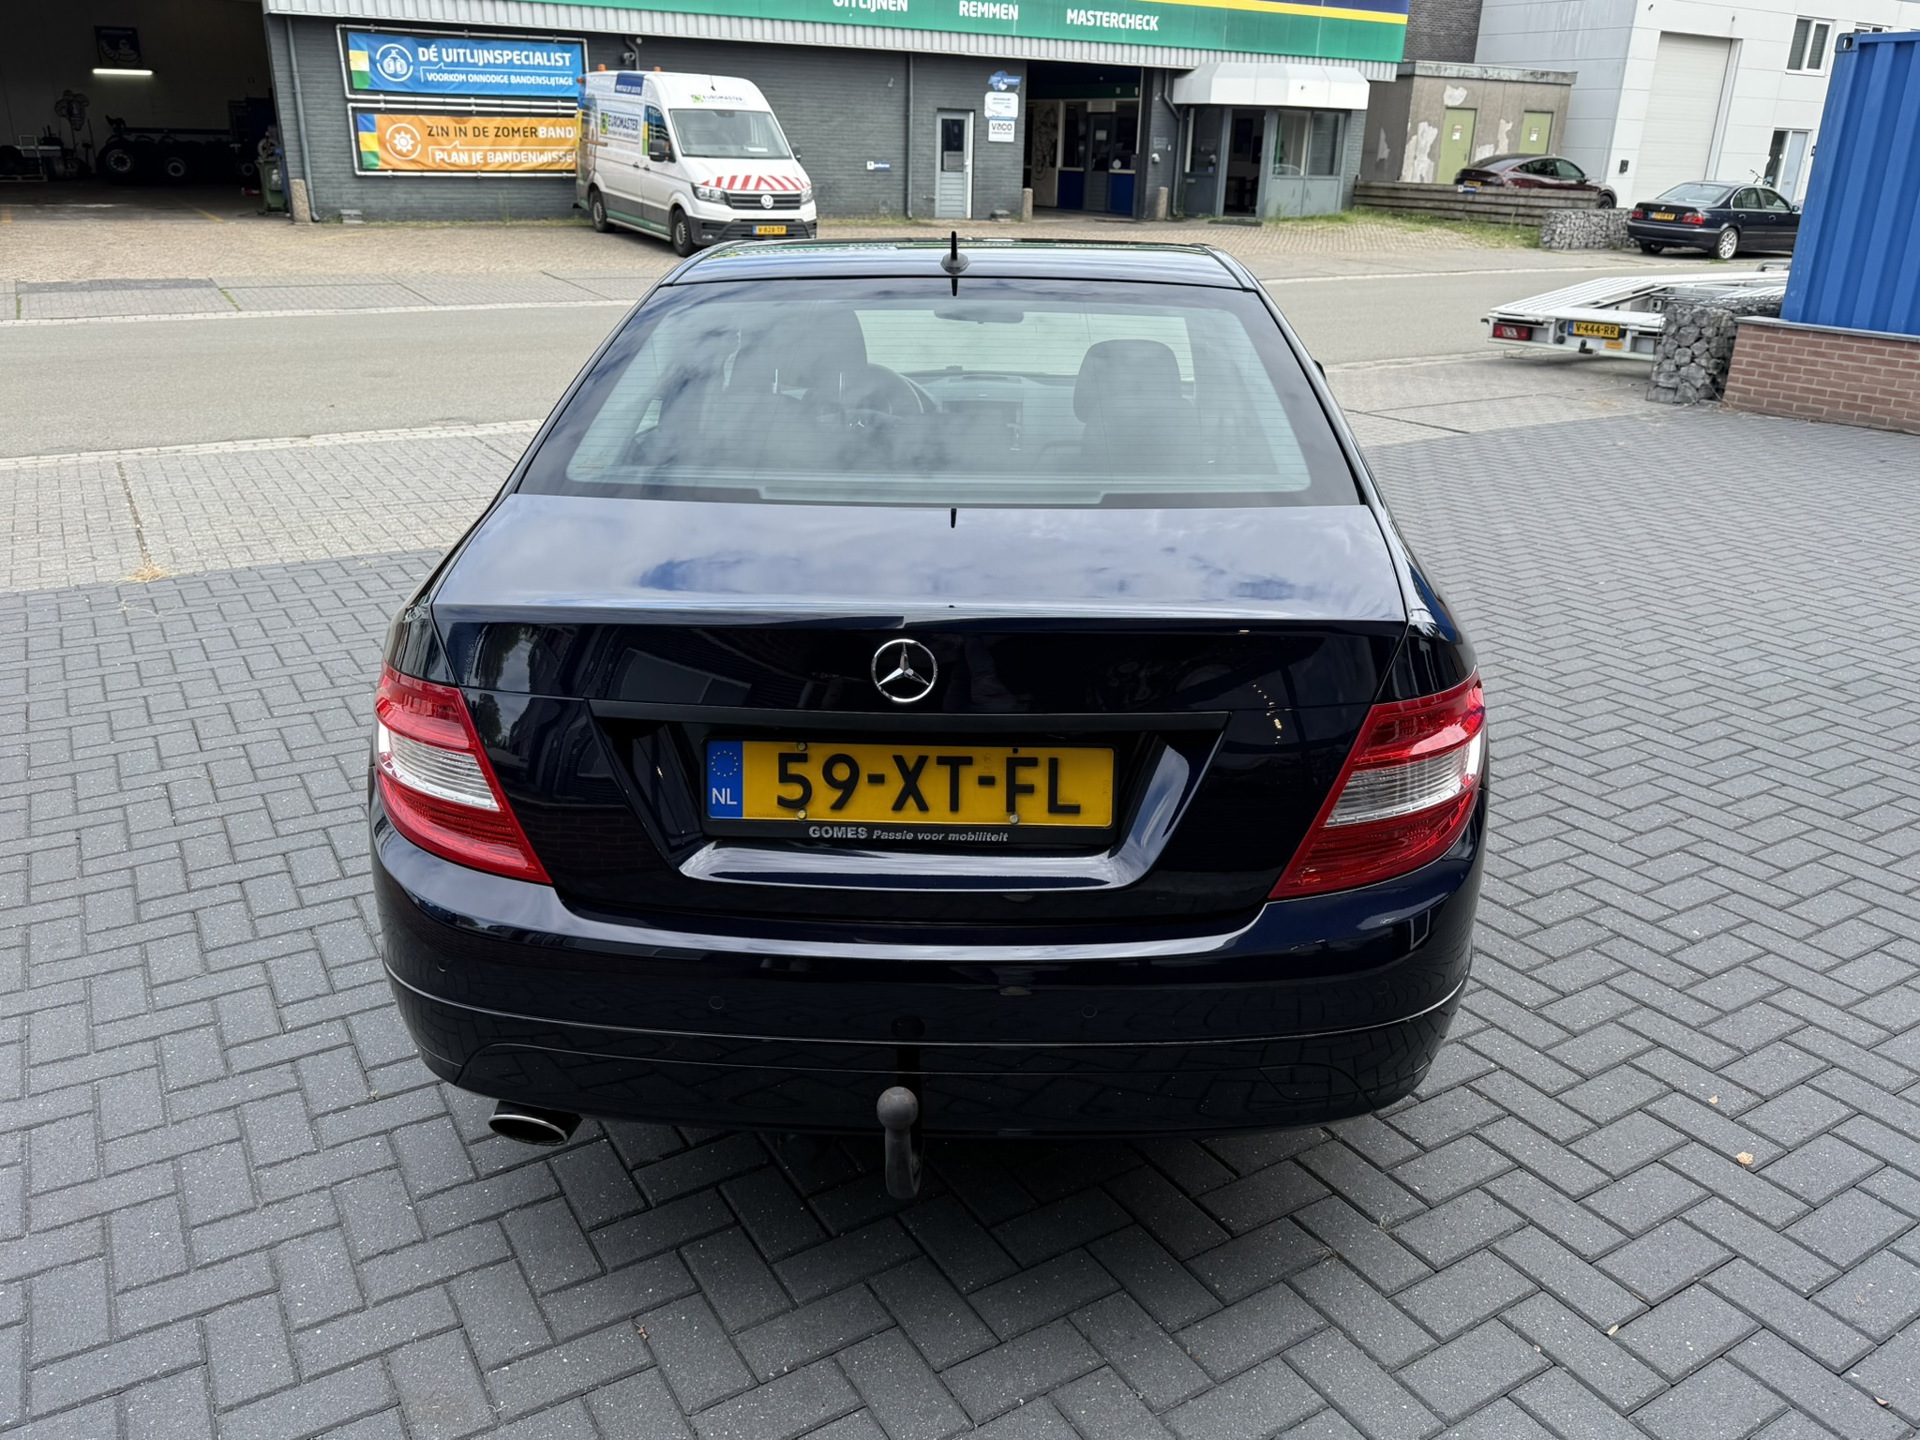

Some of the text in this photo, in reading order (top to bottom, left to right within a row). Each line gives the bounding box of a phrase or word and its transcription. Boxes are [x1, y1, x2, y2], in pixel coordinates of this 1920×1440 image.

[959, 0, 1018, 20] REMMEN
[1066, 8, 1160, 31] MASTERCHECK
[418, 44, 572, 67] DÉ UITLIJNSPECIALIST
[426, 72, 573, 86] VOORKOM ONNODIGE BANDENSLIJTAGE
[427, 125, 577, 139] ZIN IN DE ZOMERBAND
[435, 151, 468, 163] PLAN
[471, 151, 484, 165] JE
[1575, 322, 1617, 336] V-444-RR
[776, 751, 1081, 814] 59-XT-FL
[711, 787, 738, 805] NL
[809, 826, 1009, 842] GOMES Passie voor mobiliteit
